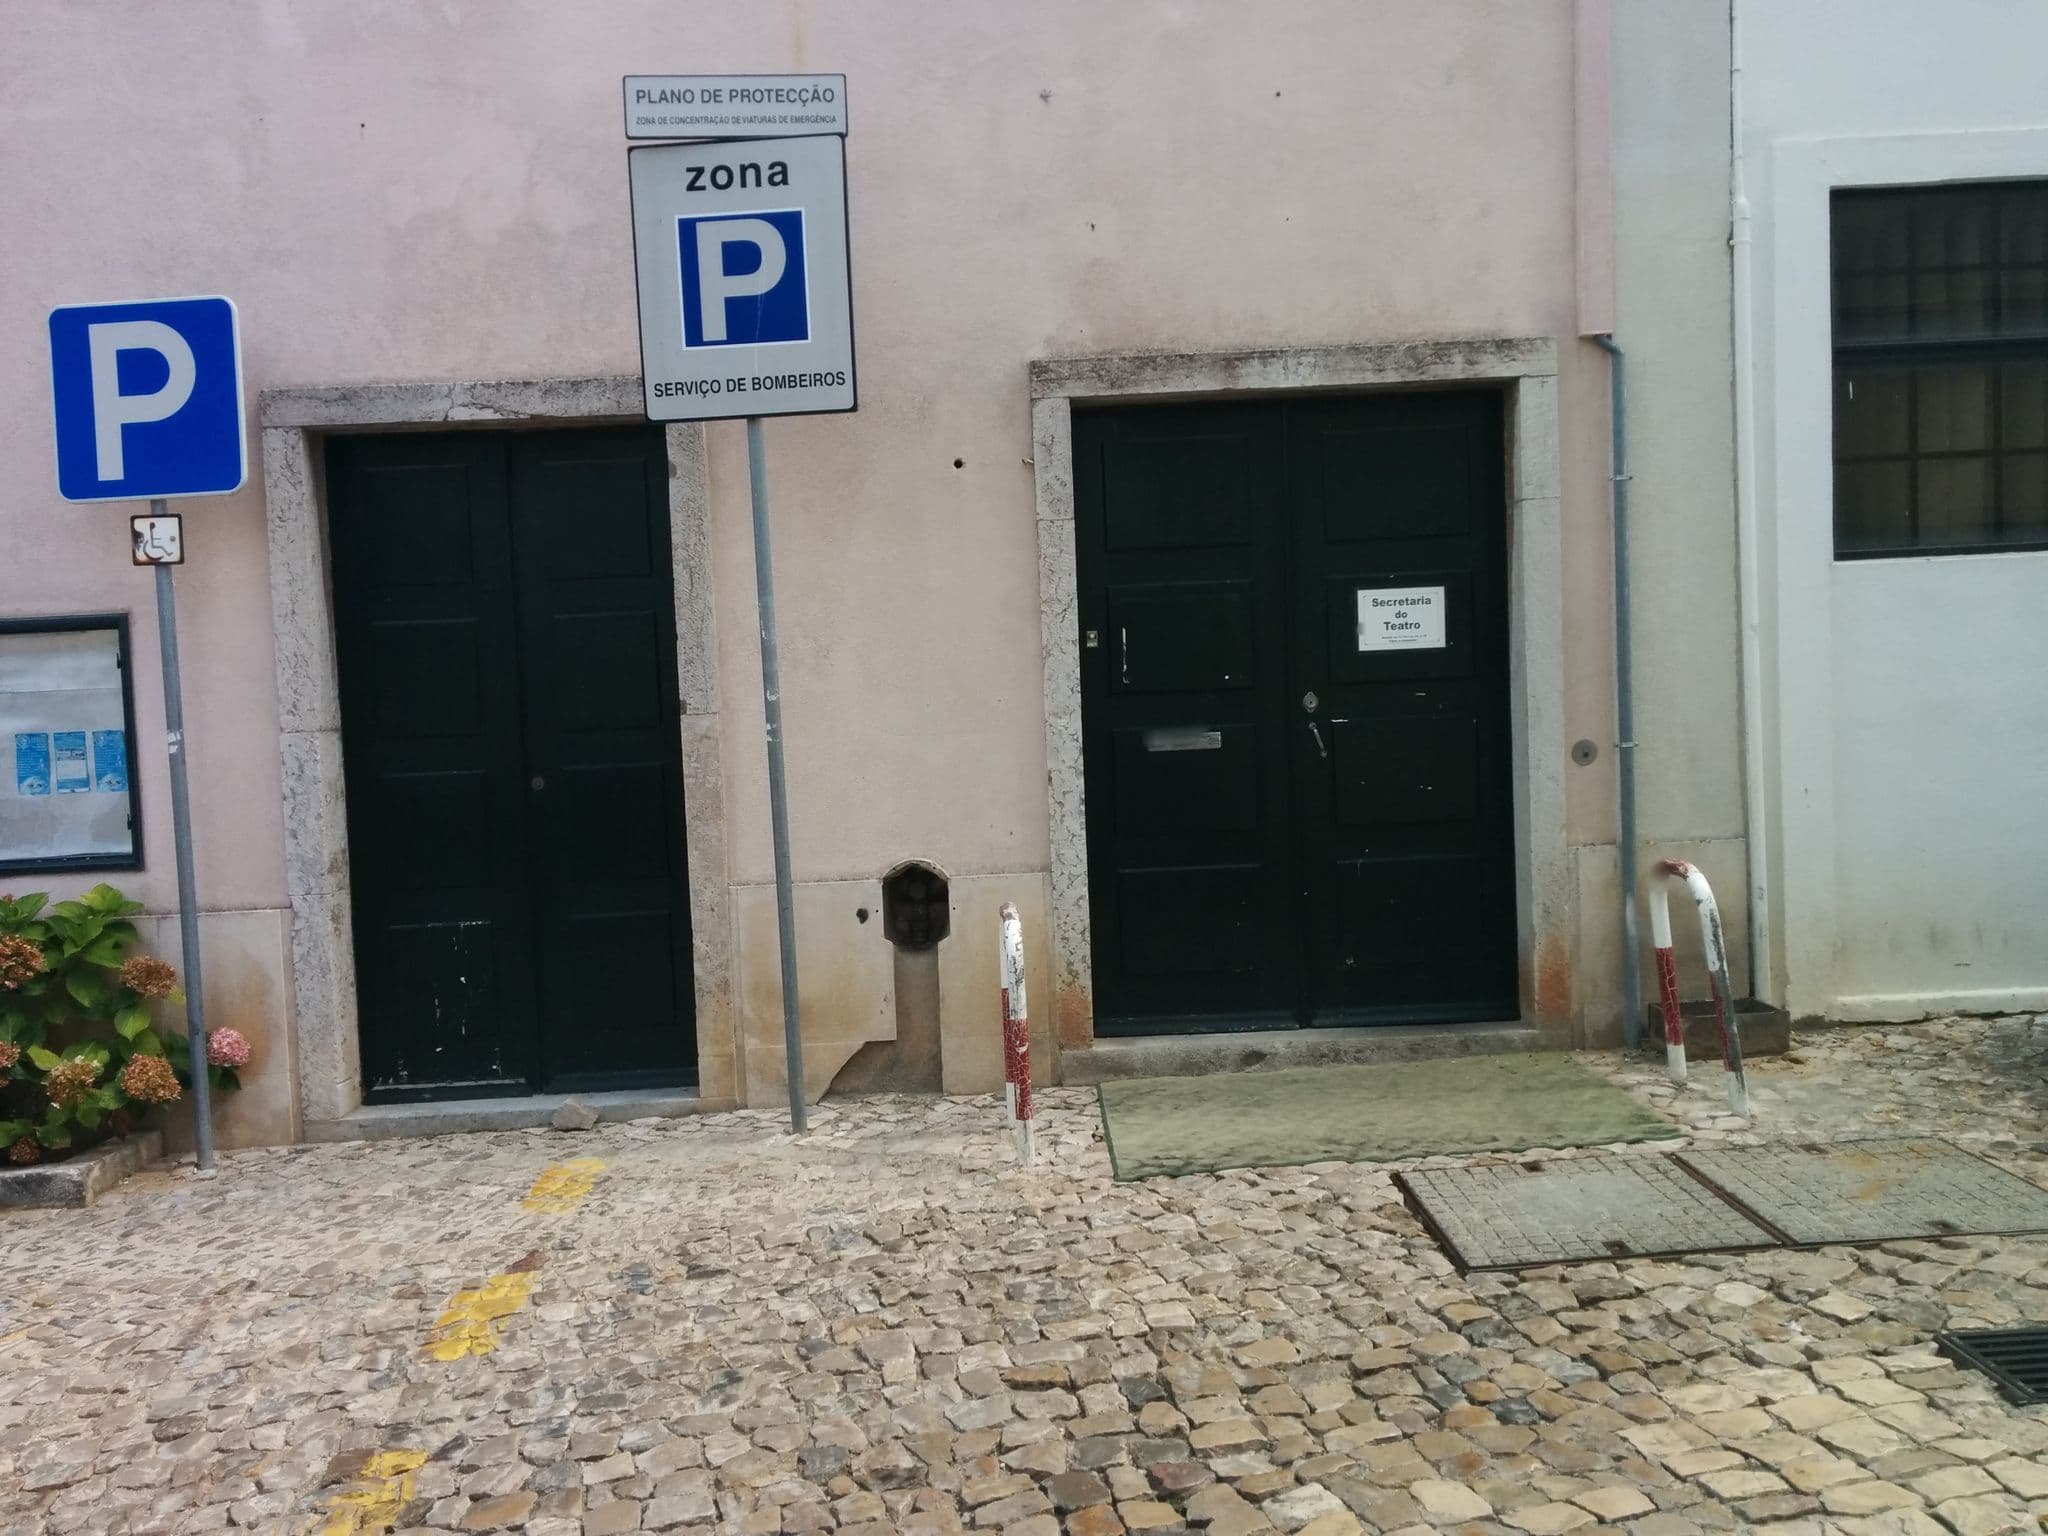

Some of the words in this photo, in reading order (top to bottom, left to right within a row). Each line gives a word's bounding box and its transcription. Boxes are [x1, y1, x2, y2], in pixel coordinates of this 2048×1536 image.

[636, 89, 695, 104] PLANO
[700, 89, 723, 104] DE
[729, 84, 835, 107] PROTECÇÃO
[636, 116, 656, 125] ZONA
[657, 116, 669, 125] DE
[669, 114, 730, 125] CONCENTRAÇÃO
[731, 115, 741, 124] DE
[742, 114, 777, 124] VIATURAS
[778, 114, 788, 123] DE
[790, 112, 837, 124] EMERGÊNCIA
[685, 161, 789, 192] zona
[696, 218, 786, 342] P
[654, 379, 721, 398] SERVIÇO
[726, 377, 747, 393] DE
[752, 371, 846, 391] BOMBEIROS
[88, 320, 196, 481] P
[1372, 596, 1432, 607] Secretaria
[1383, 621, 1421, 631] Teatro
[1395, 610, 1408, 619] do
